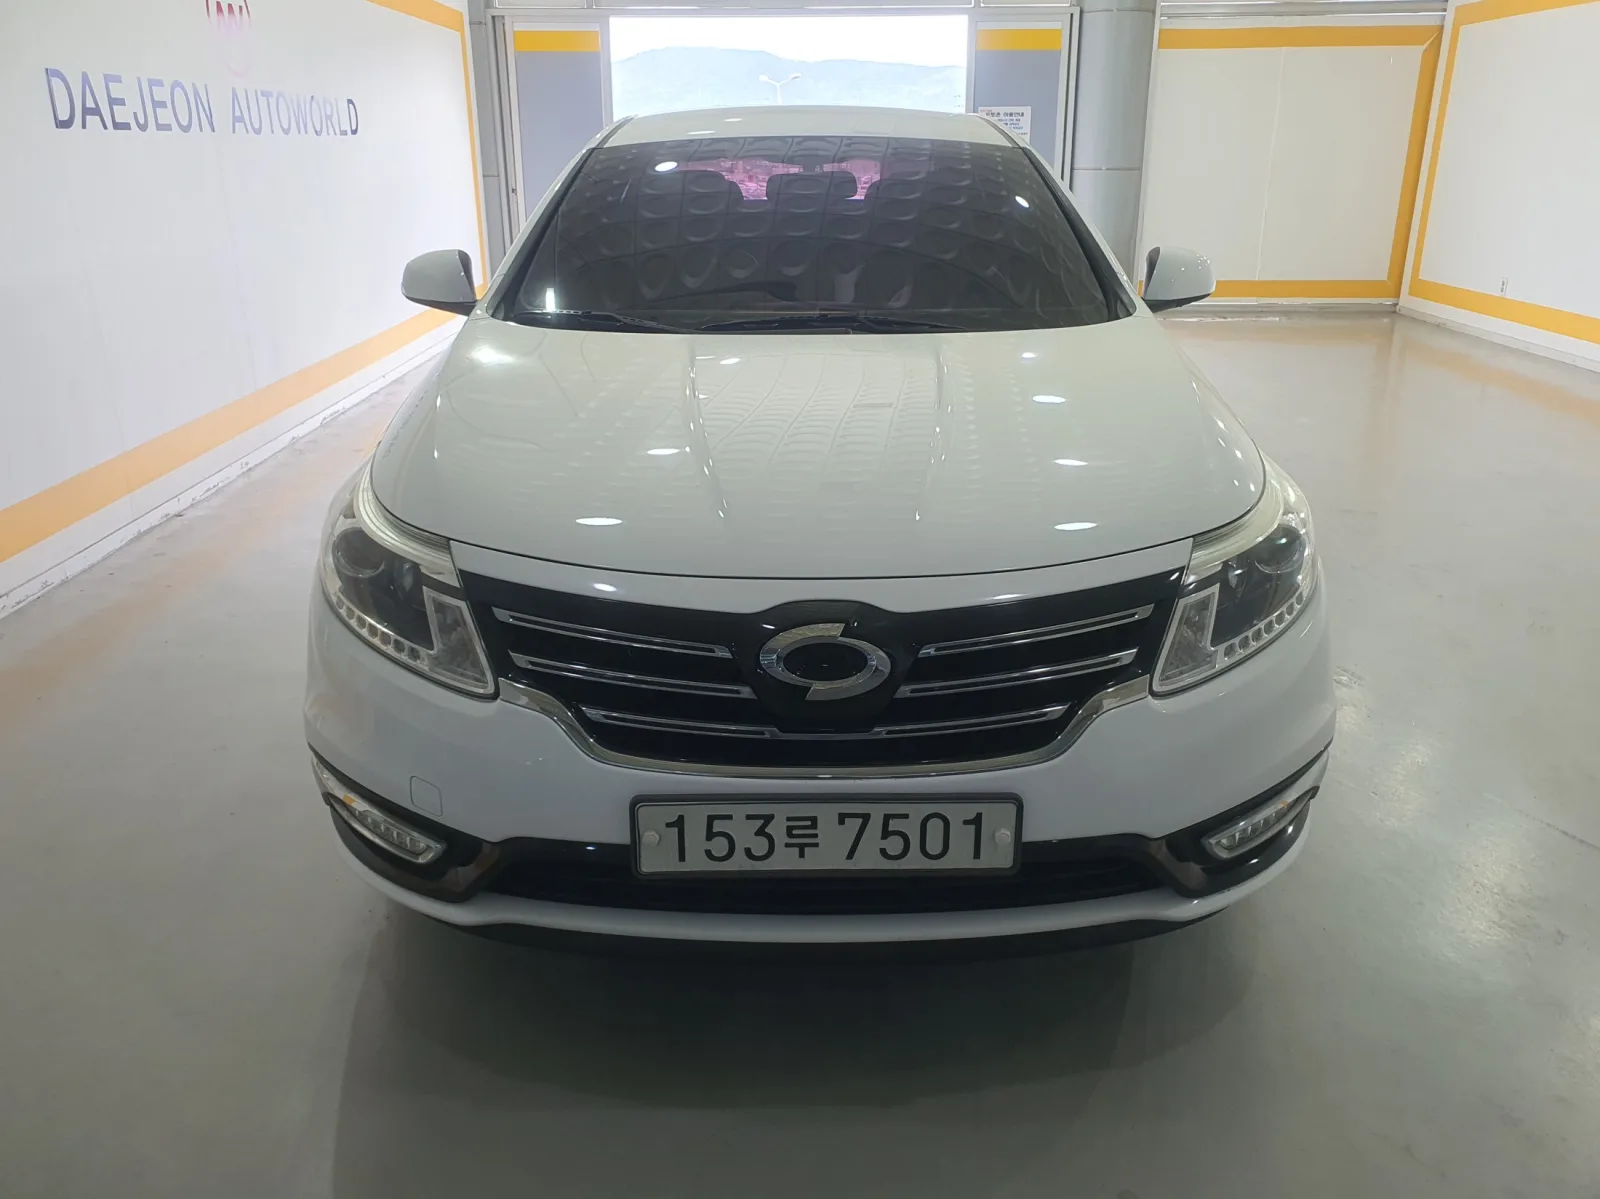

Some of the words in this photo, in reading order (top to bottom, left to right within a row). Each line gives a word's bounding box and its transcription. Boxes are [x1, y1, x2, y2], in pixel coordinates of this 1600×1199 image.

[44, 67, 216, 134] DAEJEON
[231, 86, 359, 137] AUTOWORLD
[664, 812, 820, 862] 153루
[837, 811, 984, 861] 7501
